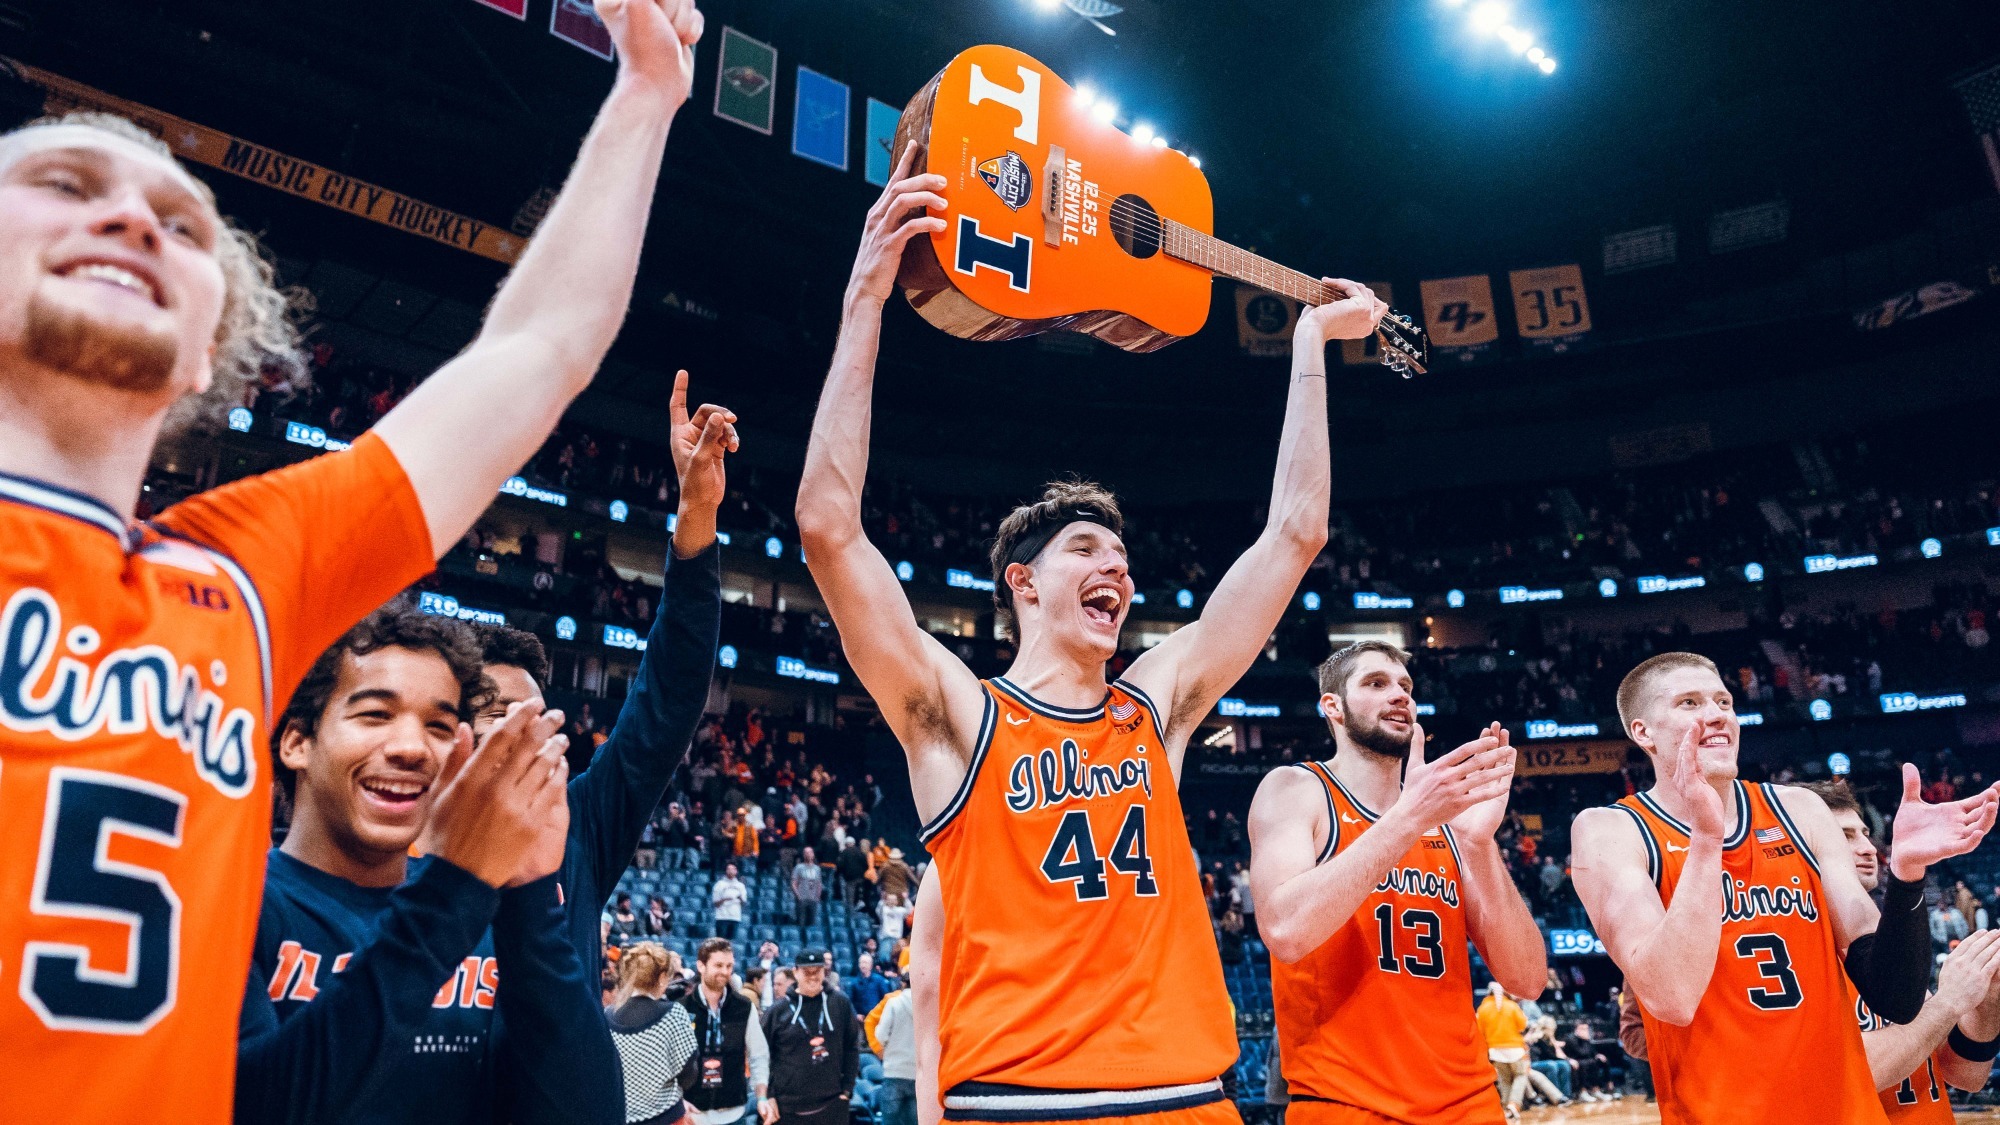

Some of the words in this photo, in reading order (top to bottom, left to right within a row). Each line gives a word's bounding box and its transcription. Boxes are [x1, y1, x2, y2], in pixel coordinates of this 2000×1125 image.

[969, 63, 1041, 145] T
[1001, 161, 1011, 197] Madness
[1008, 153, 1020, 185] MUSIC
[224, 139, 315, 193] MUSIC
[319, 173, 383, 215] CITY
[387, 195, 483, 249] HOCKEY
[1005, 185, 1018, 208] CITY
[1062, 158, 1082, 245] NASHVILLE
[1081, 180, 1099, 237] 12.6.25
[954, 213, 1033, 294] I
[1521, 286, 1582, 330] 35
[526, 487, 568, 507] SPORTS
[1837, 555, 1879, 570] SPORTS
[1527, 589, 1564, 601] SPORTS
[1666, 576, 1706, 591] SPORTS
[457, 606, 506, 627] SPORTS
[1380, 598, 1414, 609] SPORTS
[804, 668, 840, 684] SPORTS
[1245, 706, 1281, 717] SPORTS
[1917, 694, 1967, 710] SPORTS
[1557, 723, 1599, 737] SPORTS
[1523, 748, 1591, 767] 102.5
[1005, 738, 1152, 814] Illinoi
[1039, 804, 1160, 903] 44
[1722, 870, 1819, 924] linois
[1374, 903, 1446, 980] 13
[1734, 933, 1804, 1010] 3
